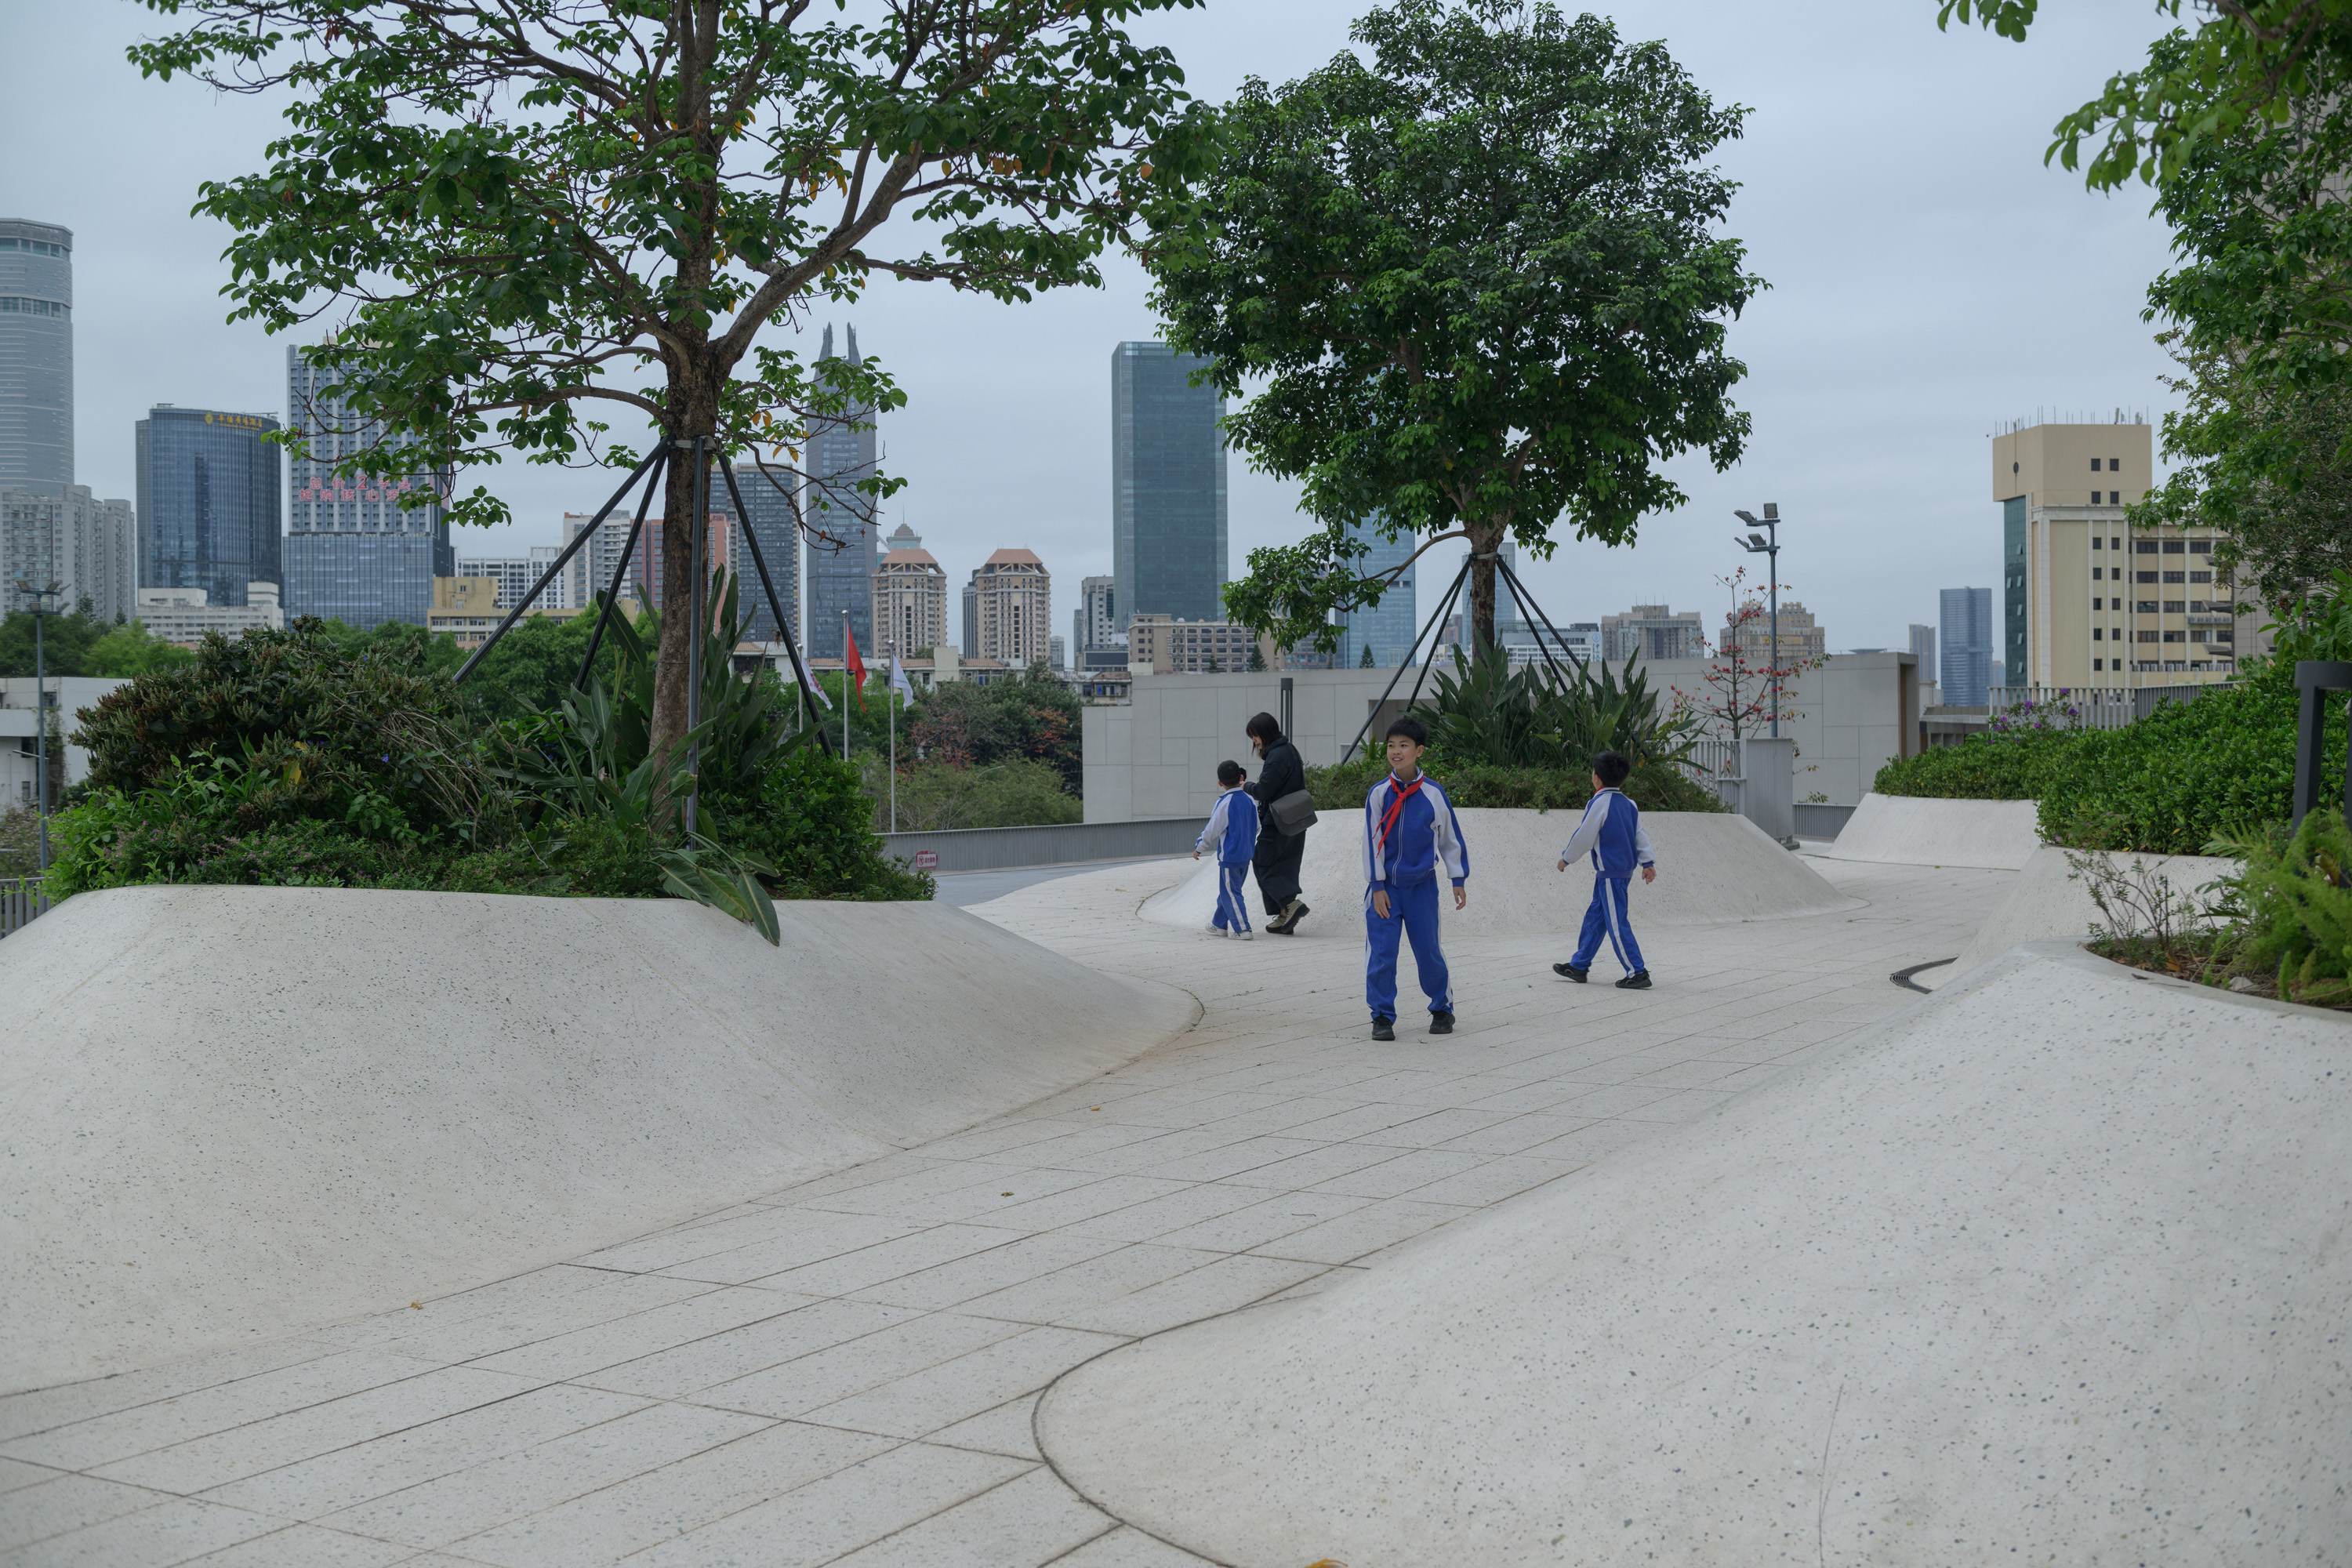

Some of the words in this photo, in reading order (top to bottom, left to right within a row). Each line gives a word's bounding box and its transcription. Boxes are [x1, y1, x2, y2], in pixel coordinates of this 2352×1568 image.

[310, 475, 411, 490] 总价2字头
[299, 489, 418, 502] 抢购核心资
